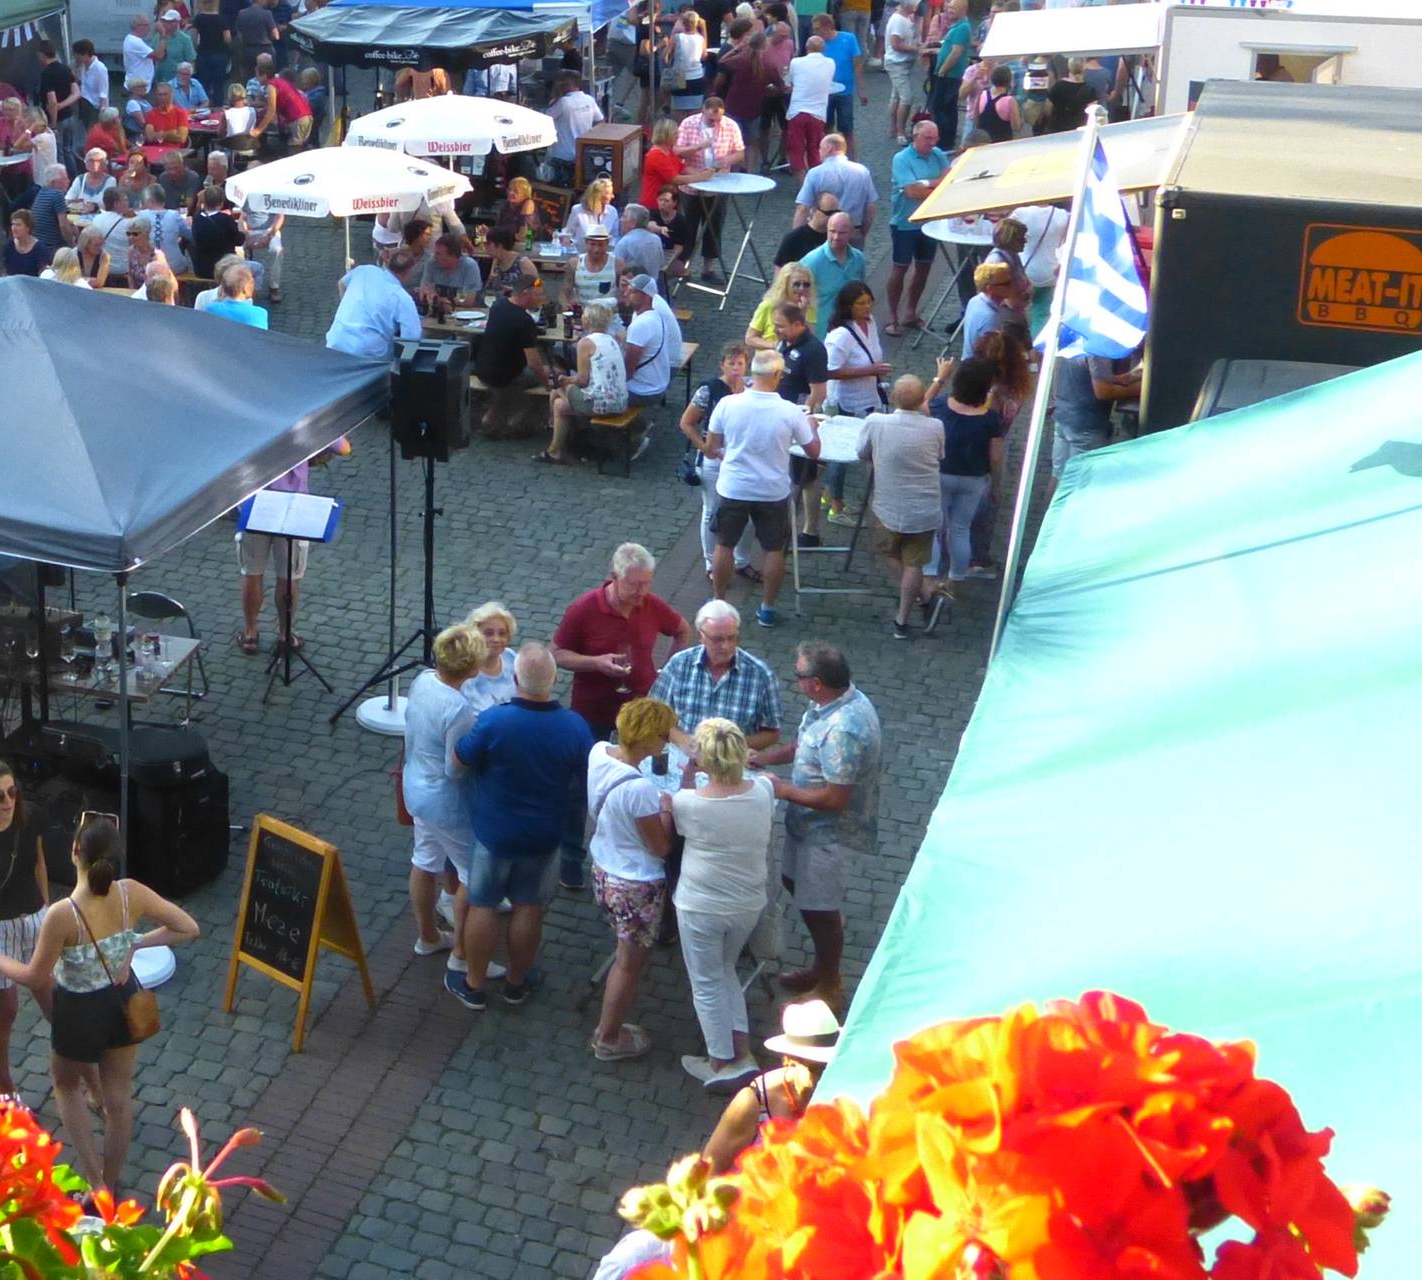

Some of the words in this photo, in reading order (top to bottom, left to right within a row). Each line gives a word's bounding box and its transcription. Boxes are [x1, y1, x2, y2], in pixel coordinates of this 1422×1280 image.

[427, 141, 472, 153] Weissbier
[263, 194, 319, 212] Benediktiner
[352, 197, 399, 210] Weissbier
